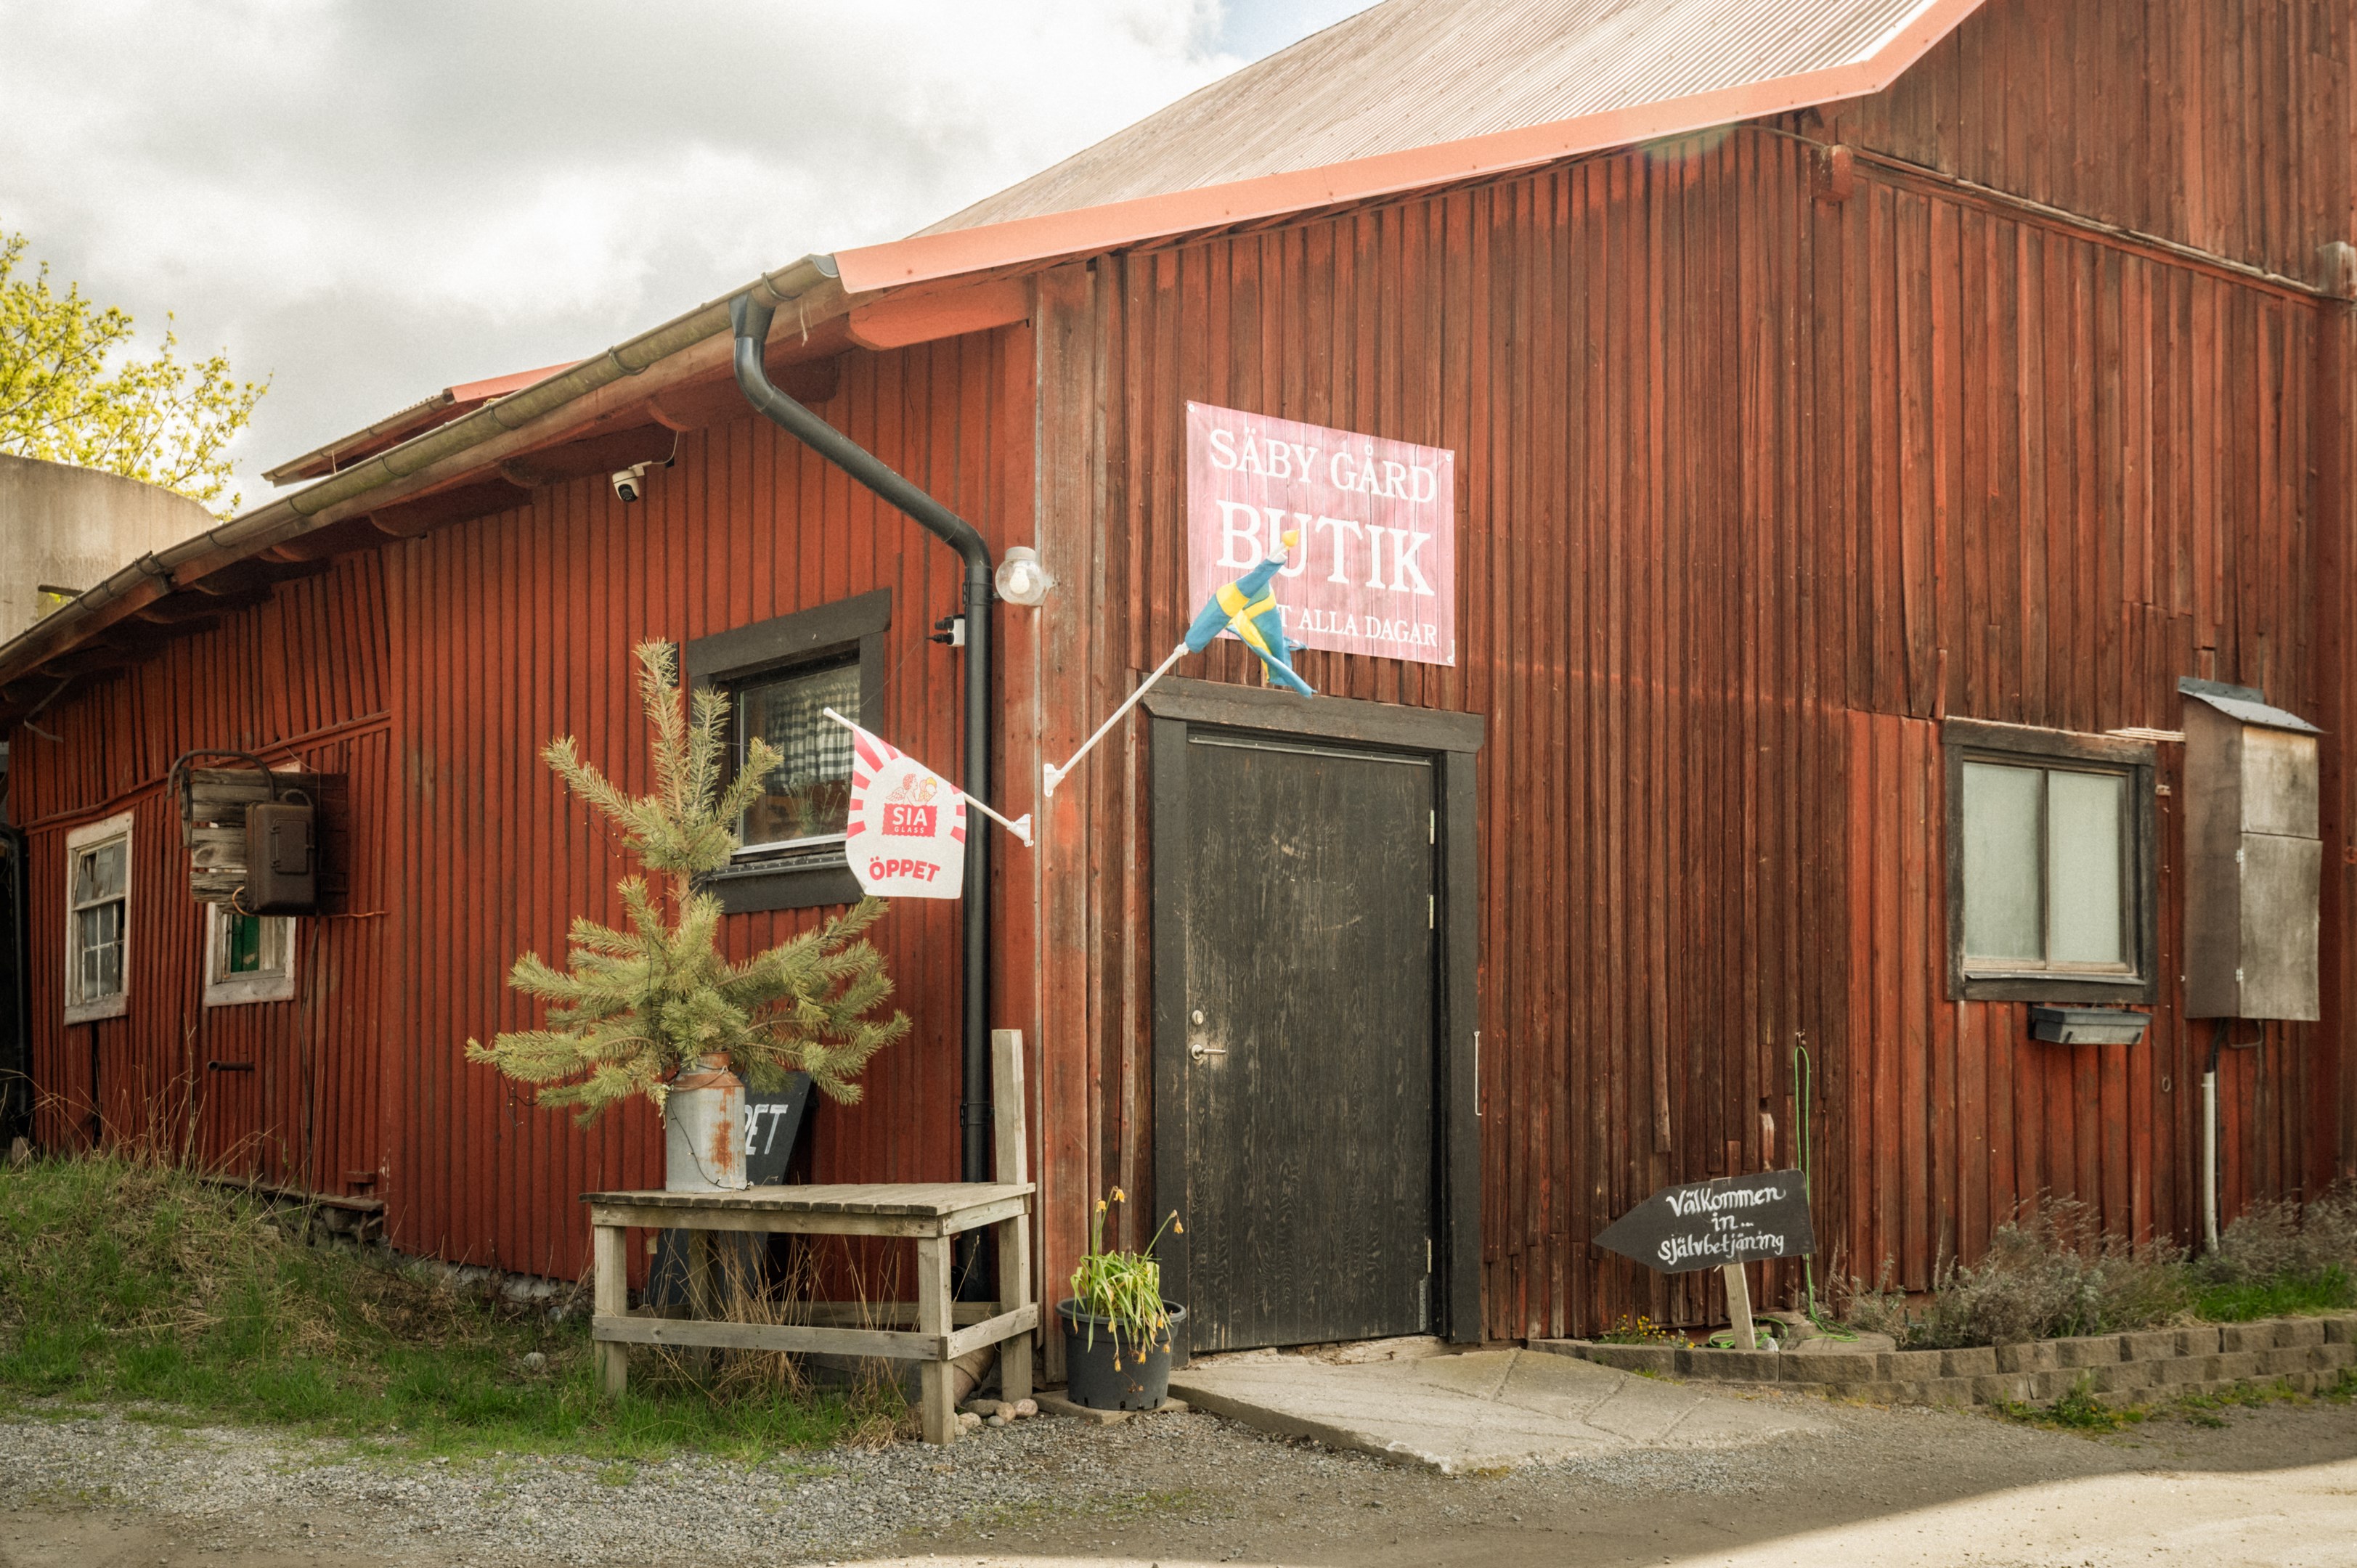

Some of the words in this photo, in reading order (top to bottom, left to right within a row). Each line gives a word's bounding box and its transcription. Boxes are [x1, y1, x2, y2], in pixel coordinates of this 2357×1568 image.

[1210, 426, 1319, 483] SÄBY
[1330, 444, 1436, 503] GÅRD
[1216, 499, 1435, 597] BUTIK
[1298, 608, 1359, 637] ALLA
[1365, 616, 1438, 647] DAGAR
[892, 807, 928, 827] SIA
[869, 856, 941, 883] ÖPPET
[1665, 1187, 1786, 1217] Välkommen
